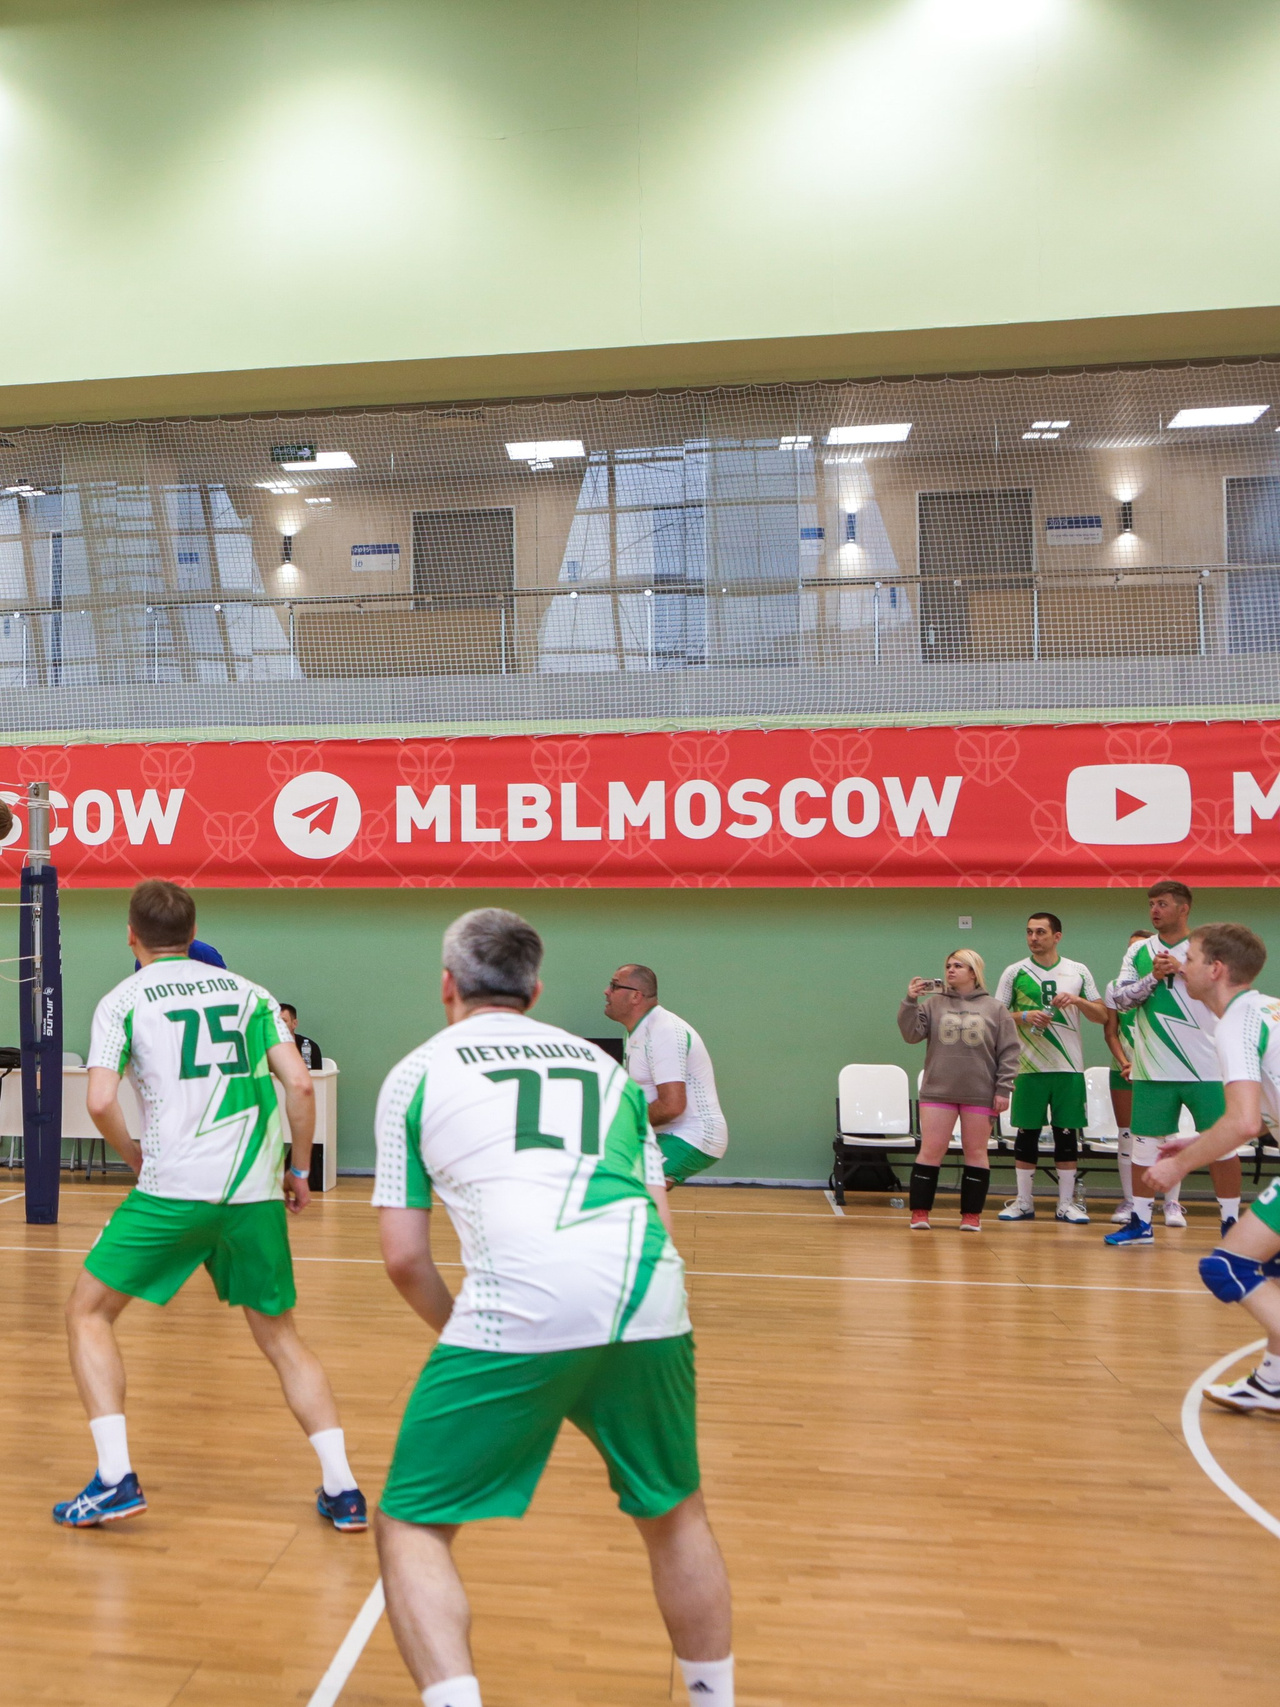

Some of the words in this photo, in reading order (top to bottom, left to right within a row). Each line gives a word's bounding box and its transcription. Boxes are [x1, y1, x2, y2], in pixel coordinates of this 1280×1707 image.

[395, 775, 964, 843] MLBLMOSCOW
[144, 978, 239, 1003] ПОГОРЕЛОВ
[1041, 980, 1057, 1007] 8
[46, 997, 54, 1037] JINLING
[163, 1004, 250, 1080] 25
[456, 1043, 596, 1065] ПЕТРАШОВ
[481, 1067, 600, 1155] 27
